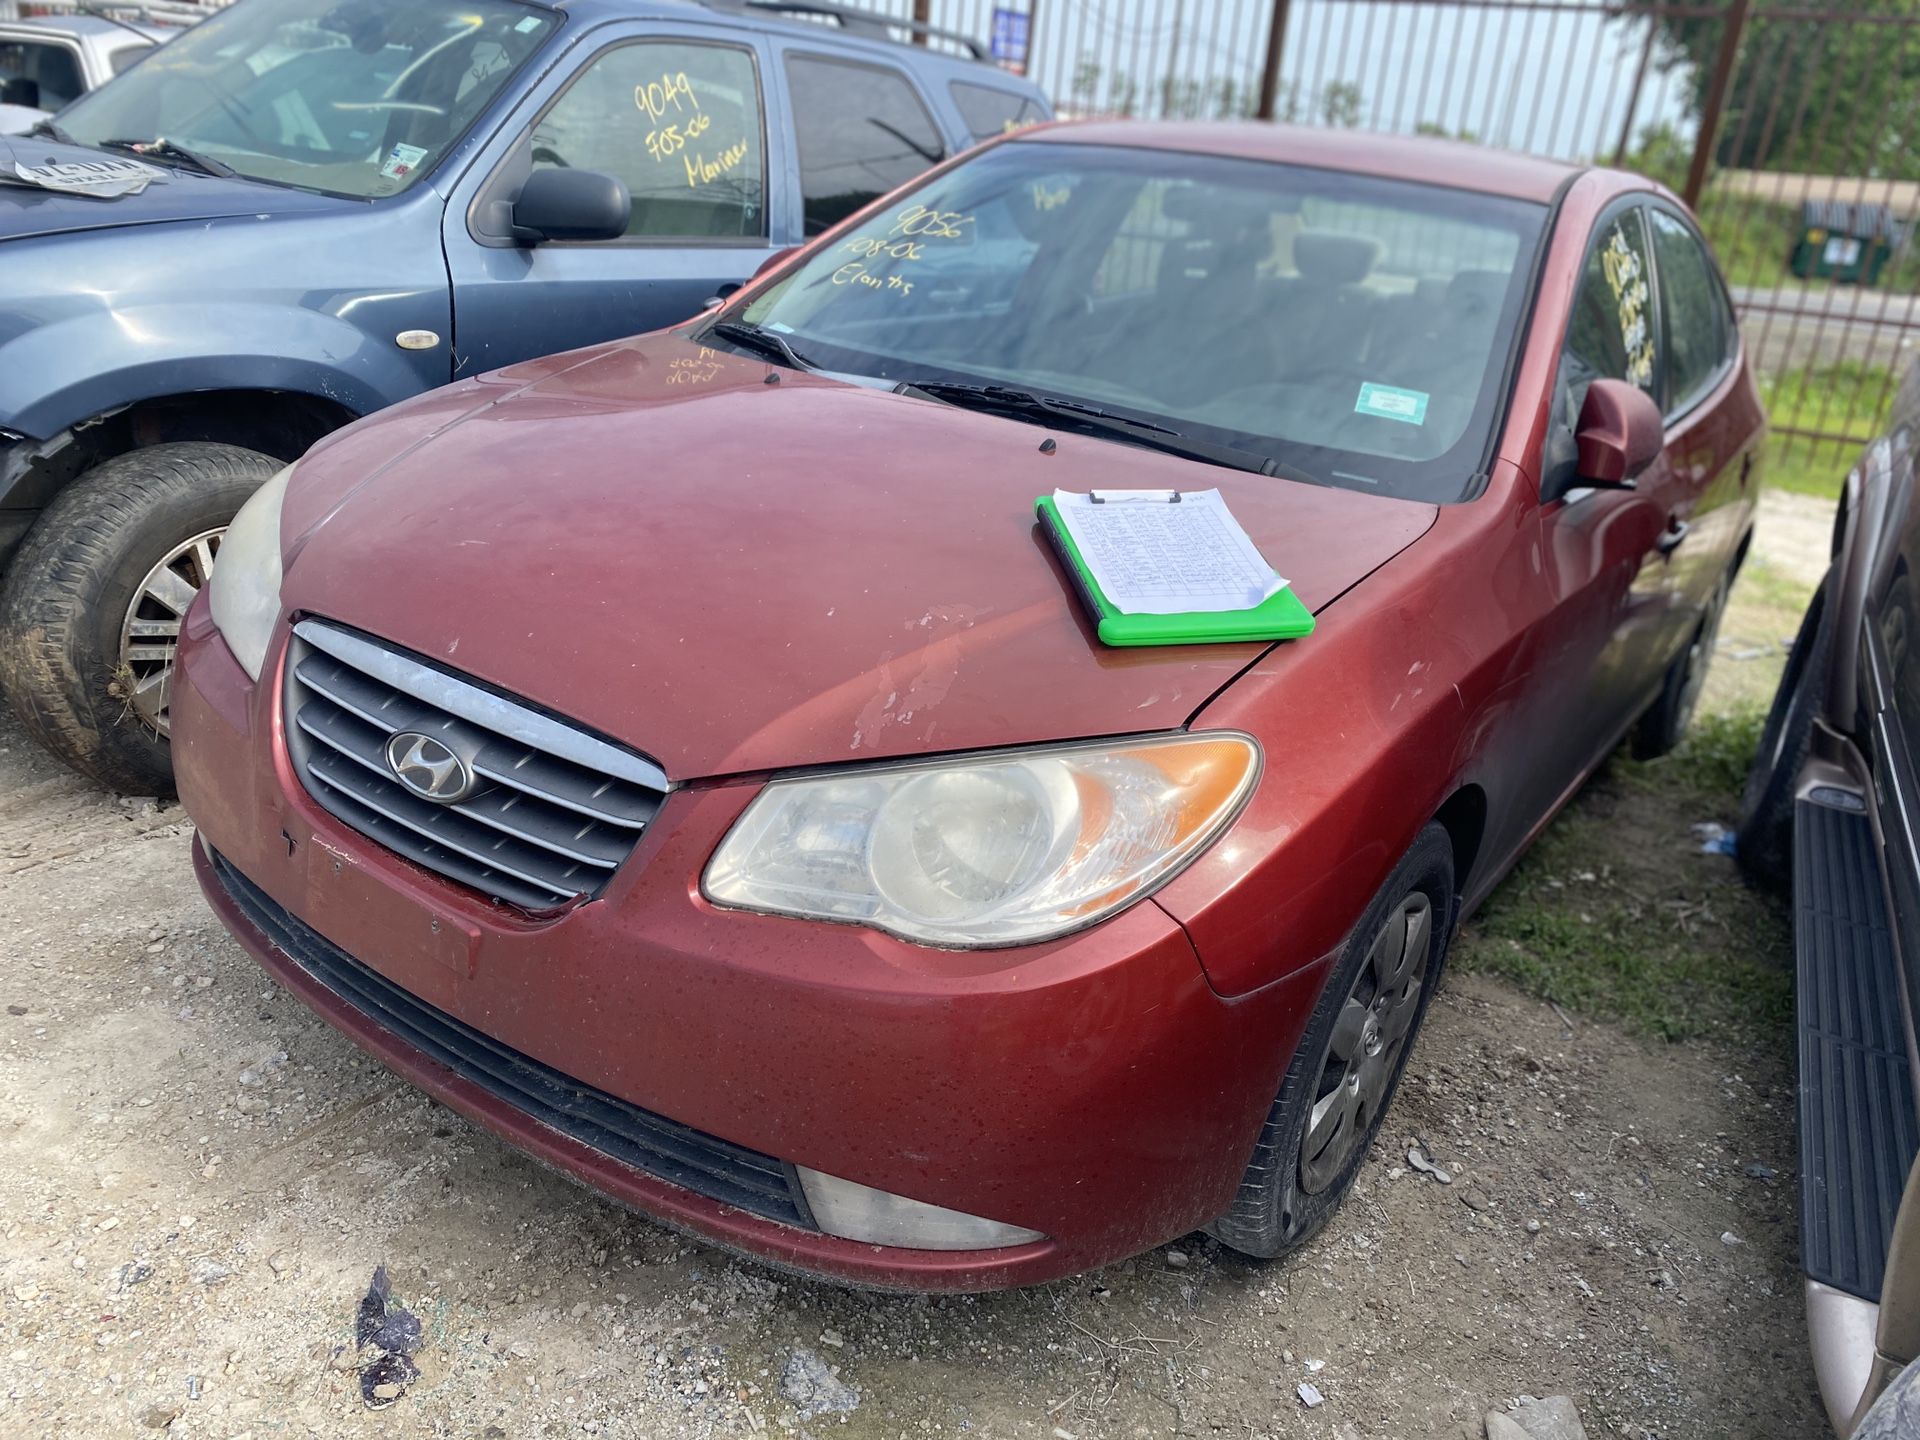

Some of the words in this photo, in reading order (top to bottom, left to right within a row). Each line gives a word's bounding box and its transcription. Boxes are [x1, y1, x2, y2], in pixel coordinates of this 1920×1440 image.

[634, 72, 700, 126] 9049
[56, 174, 121, 184] TEXAS
[682, 136, 749, 189] Mariner
[888, 204, 976, 238] 9056
